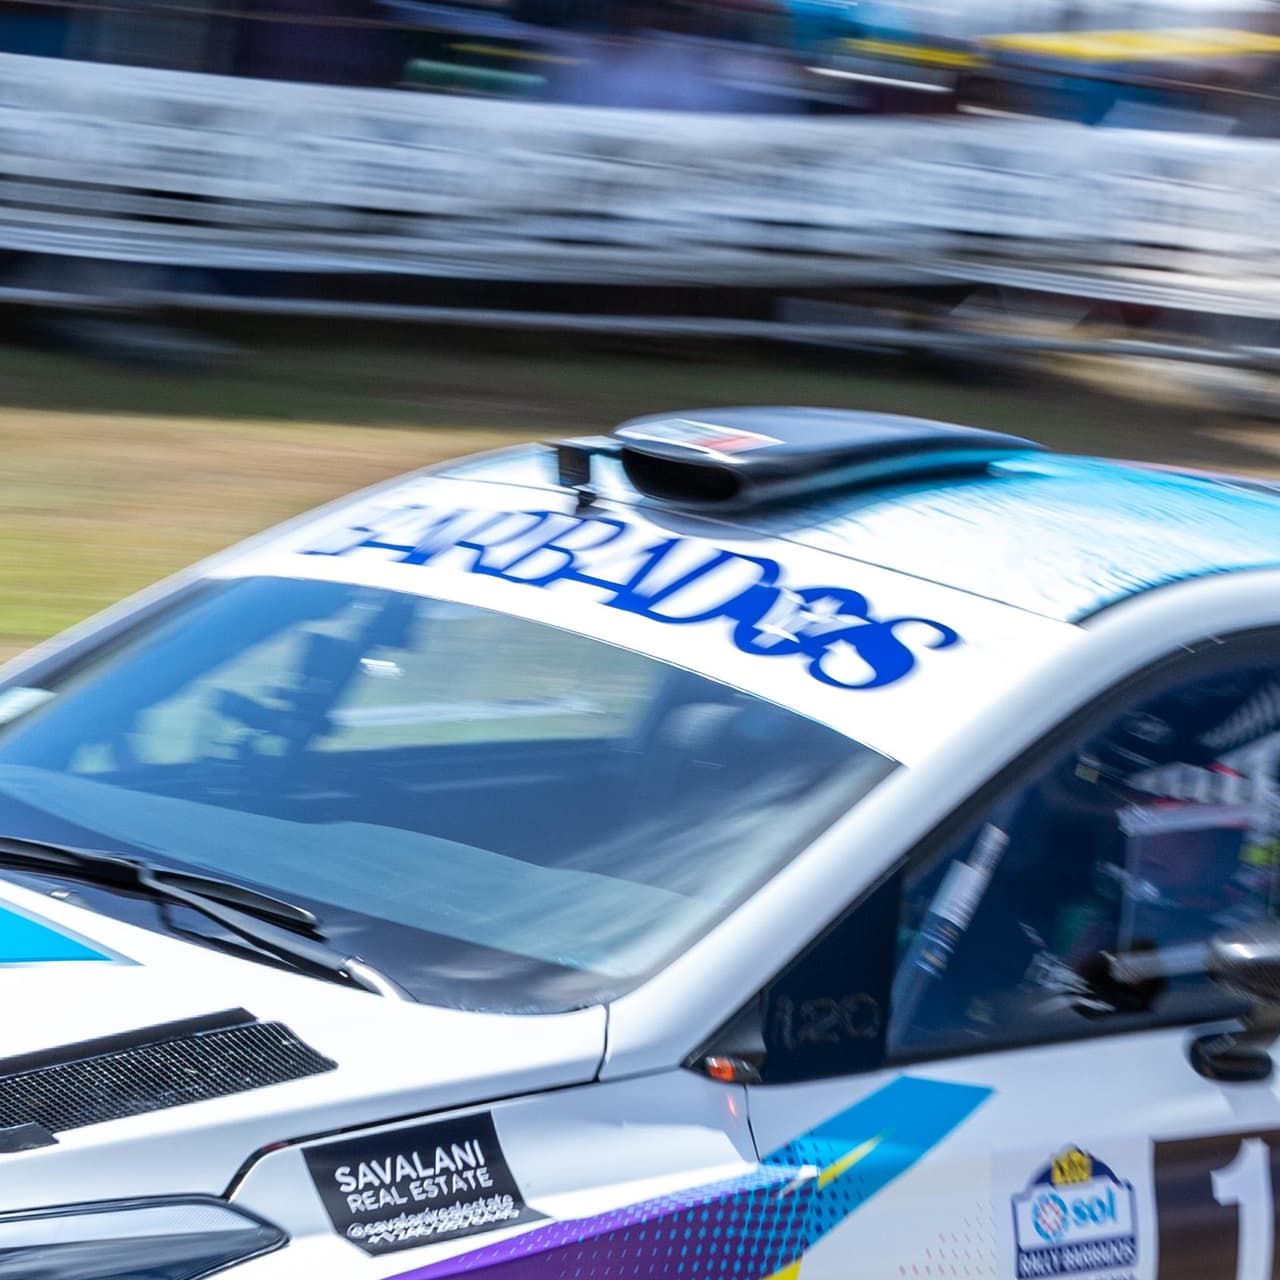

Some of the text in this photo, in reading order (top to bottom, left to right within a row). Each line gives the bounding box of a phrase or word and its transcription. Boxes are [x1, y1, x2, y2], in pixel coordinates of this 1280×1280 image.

[334, 1139, 485, 1192] SAVALANI
[346, 1167, 493, 1214] REAL ESTATE
